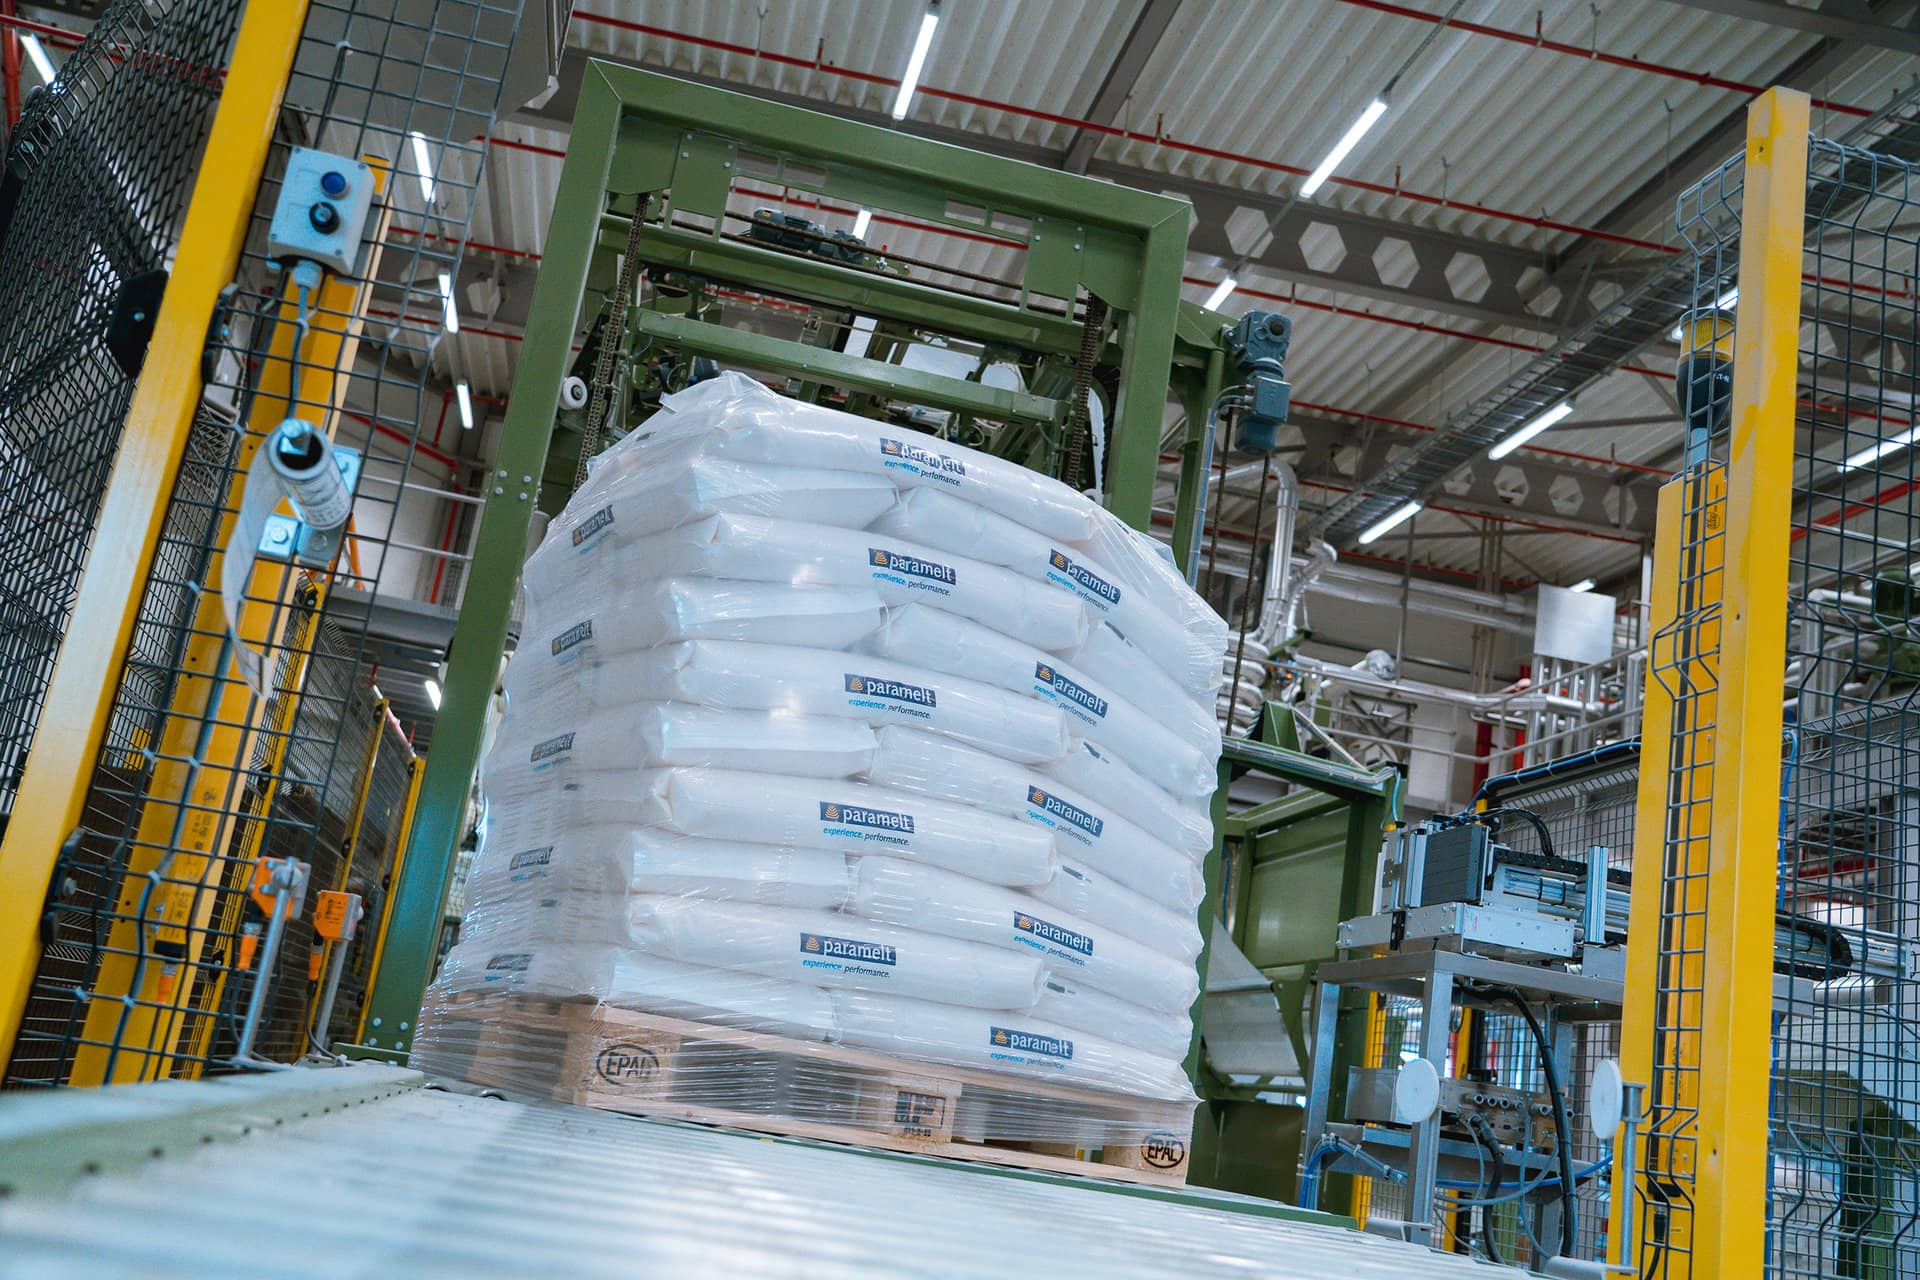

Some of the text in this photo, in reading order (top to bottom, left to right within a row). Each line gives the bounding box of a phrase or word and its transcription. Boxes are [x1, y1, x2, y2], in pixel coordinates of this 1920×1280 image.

[890, 555, 952, 581] paramelt
[867, 680, 932, 704] paramelt
[843, 808, 909, 830] paramelt
[1045, 797, 1100, 833] paramelt
[823, 827, 910, 846] experience. performance.
[1033, 921, 1090, 952] paramelt
[823, 940, 893, 962] paramelt
[843, 965, 891, 979] performance.
[1010, 1034, 1070, 1057] paramelt
[605, 1051, 652, 1079] EPAL
[1147, 1138, 1178, 1162] EPAL
